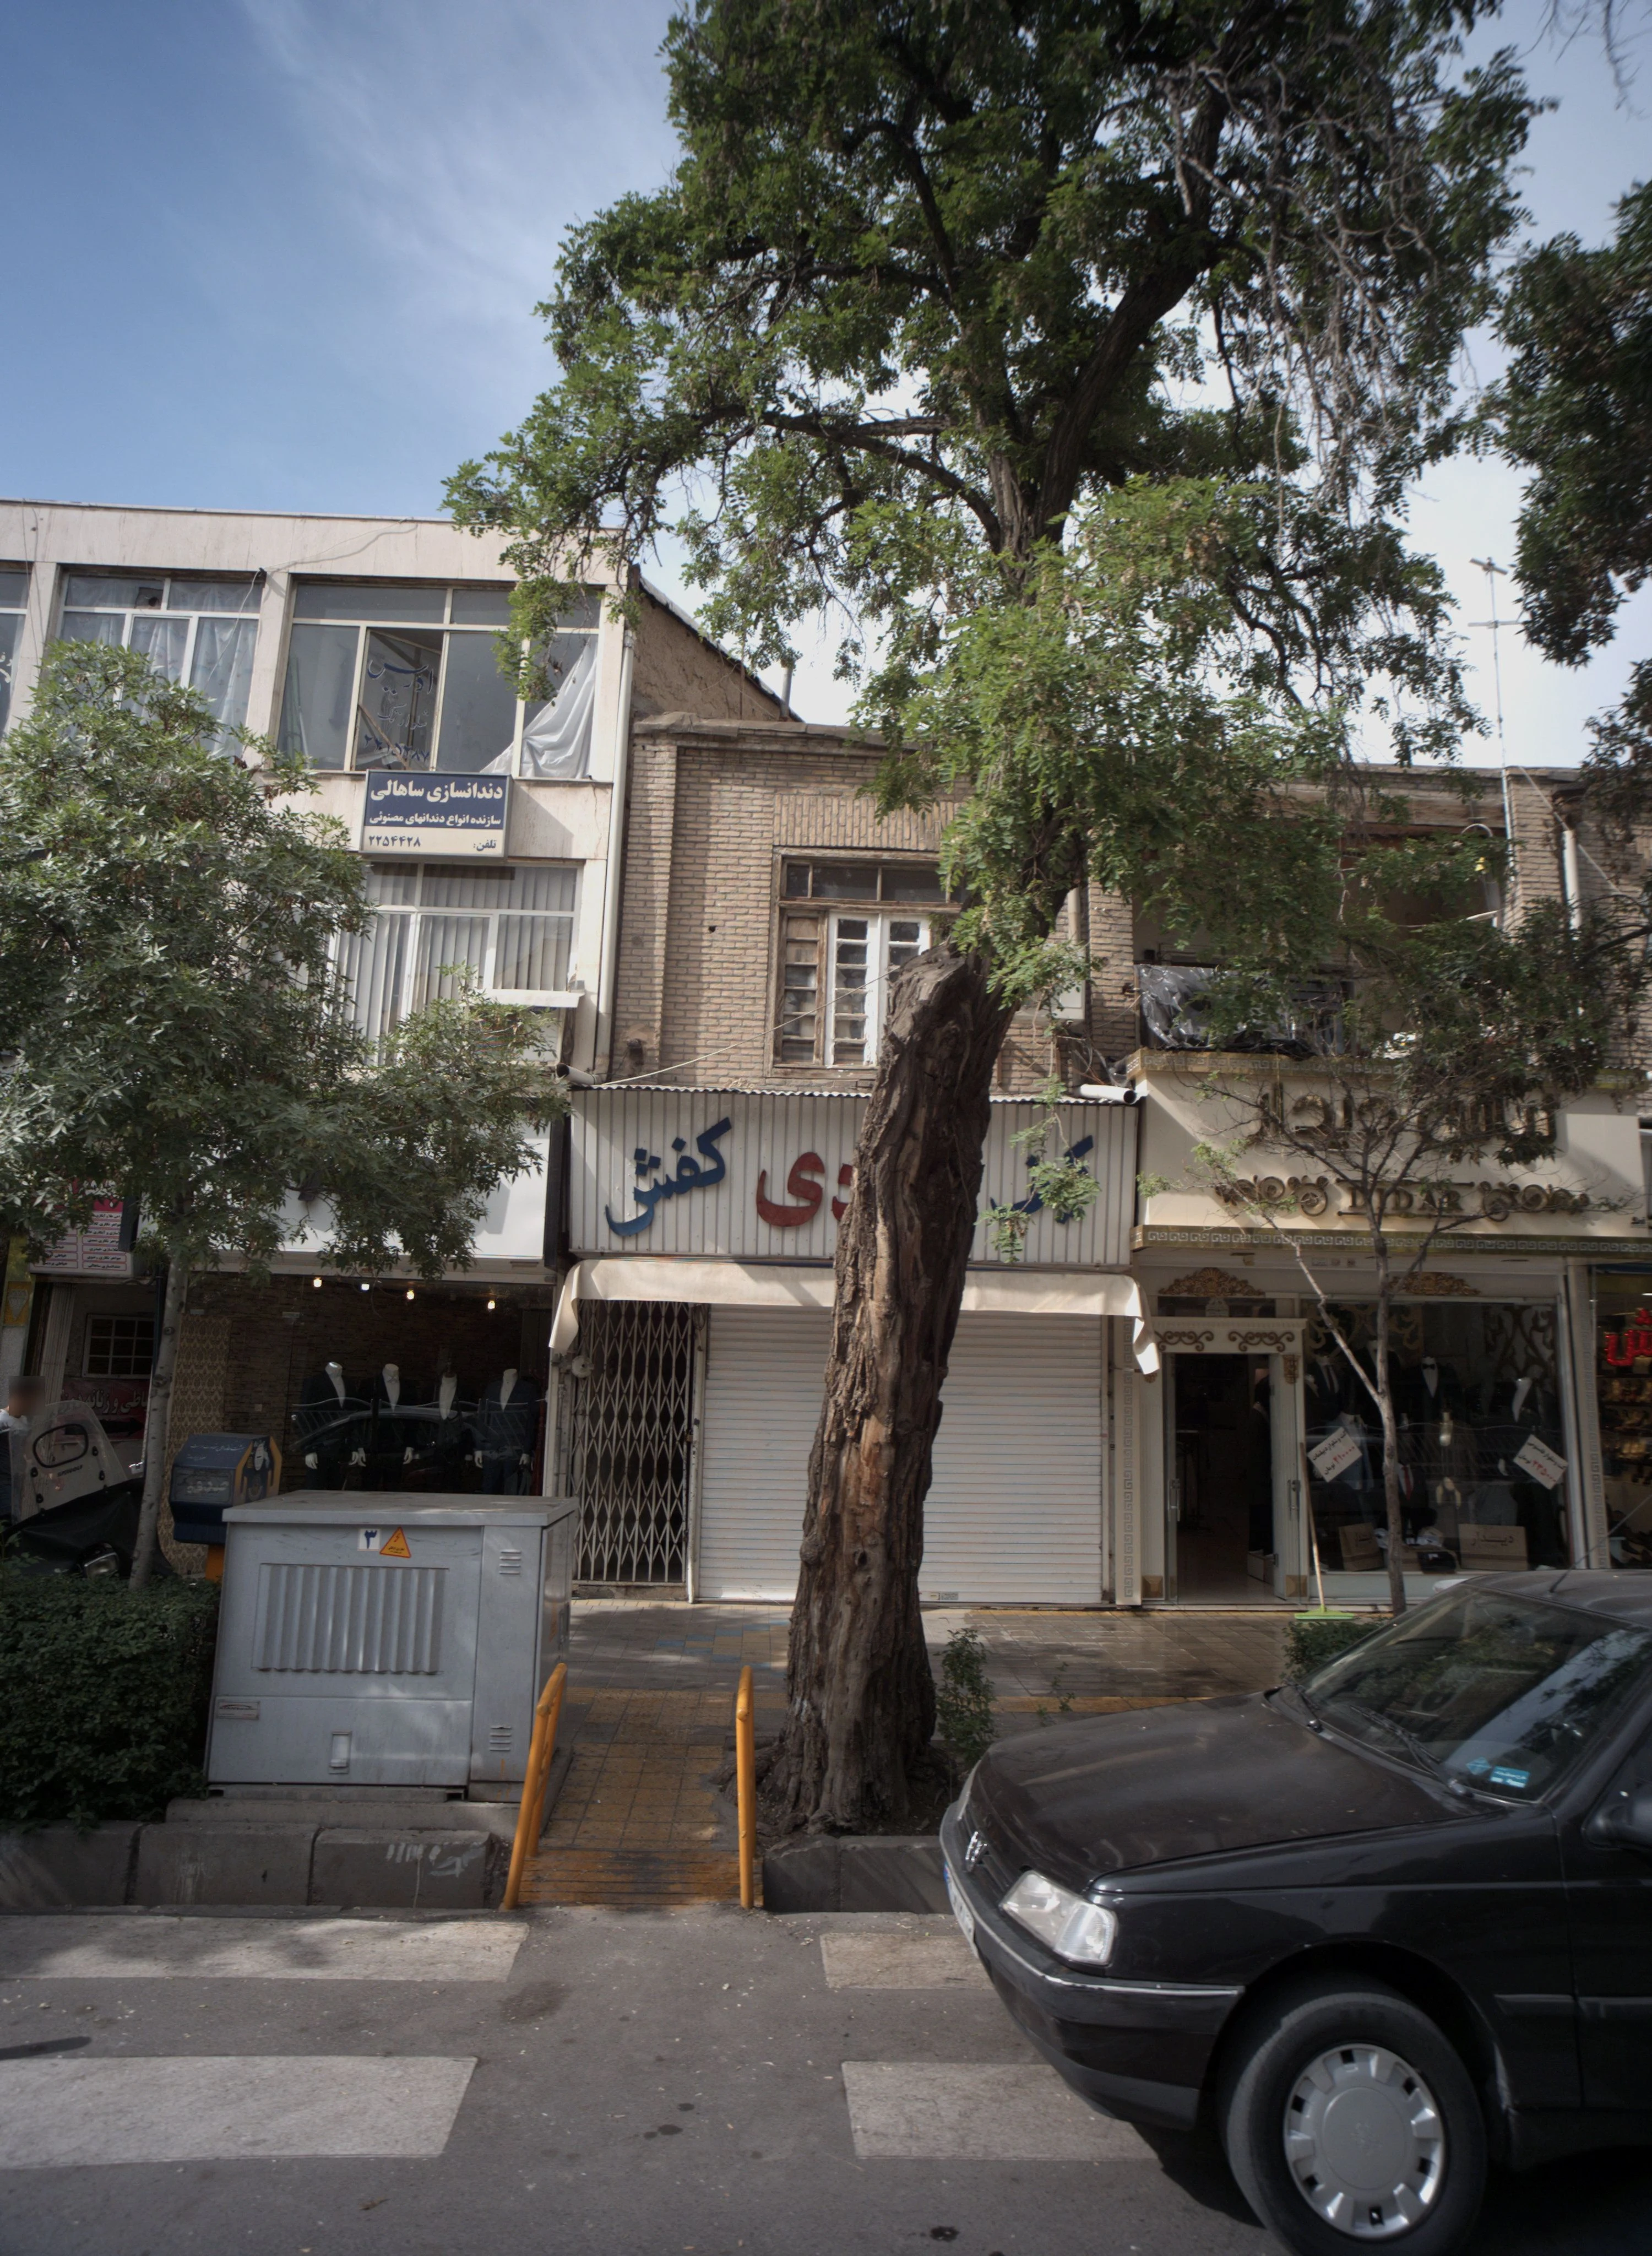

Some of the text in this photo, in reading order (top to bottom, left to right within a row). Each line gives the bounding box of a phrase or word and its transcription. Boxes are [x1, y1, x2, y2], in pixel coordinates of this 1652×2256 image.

[371, 779, 503, 803] دندانسازی ساهالی
[405, 814, 445, 825] دندانهای
[447, 815, 470, 827] انواع
[470, 815, 501, 827] سازنده
[472, 839, 496, 851] تلفن:
[605, 1116, 732, 1237] کفش
[1349, 1186, 1464, 1211] DIDAR
[364, 1529, 378, 1549] ۳
